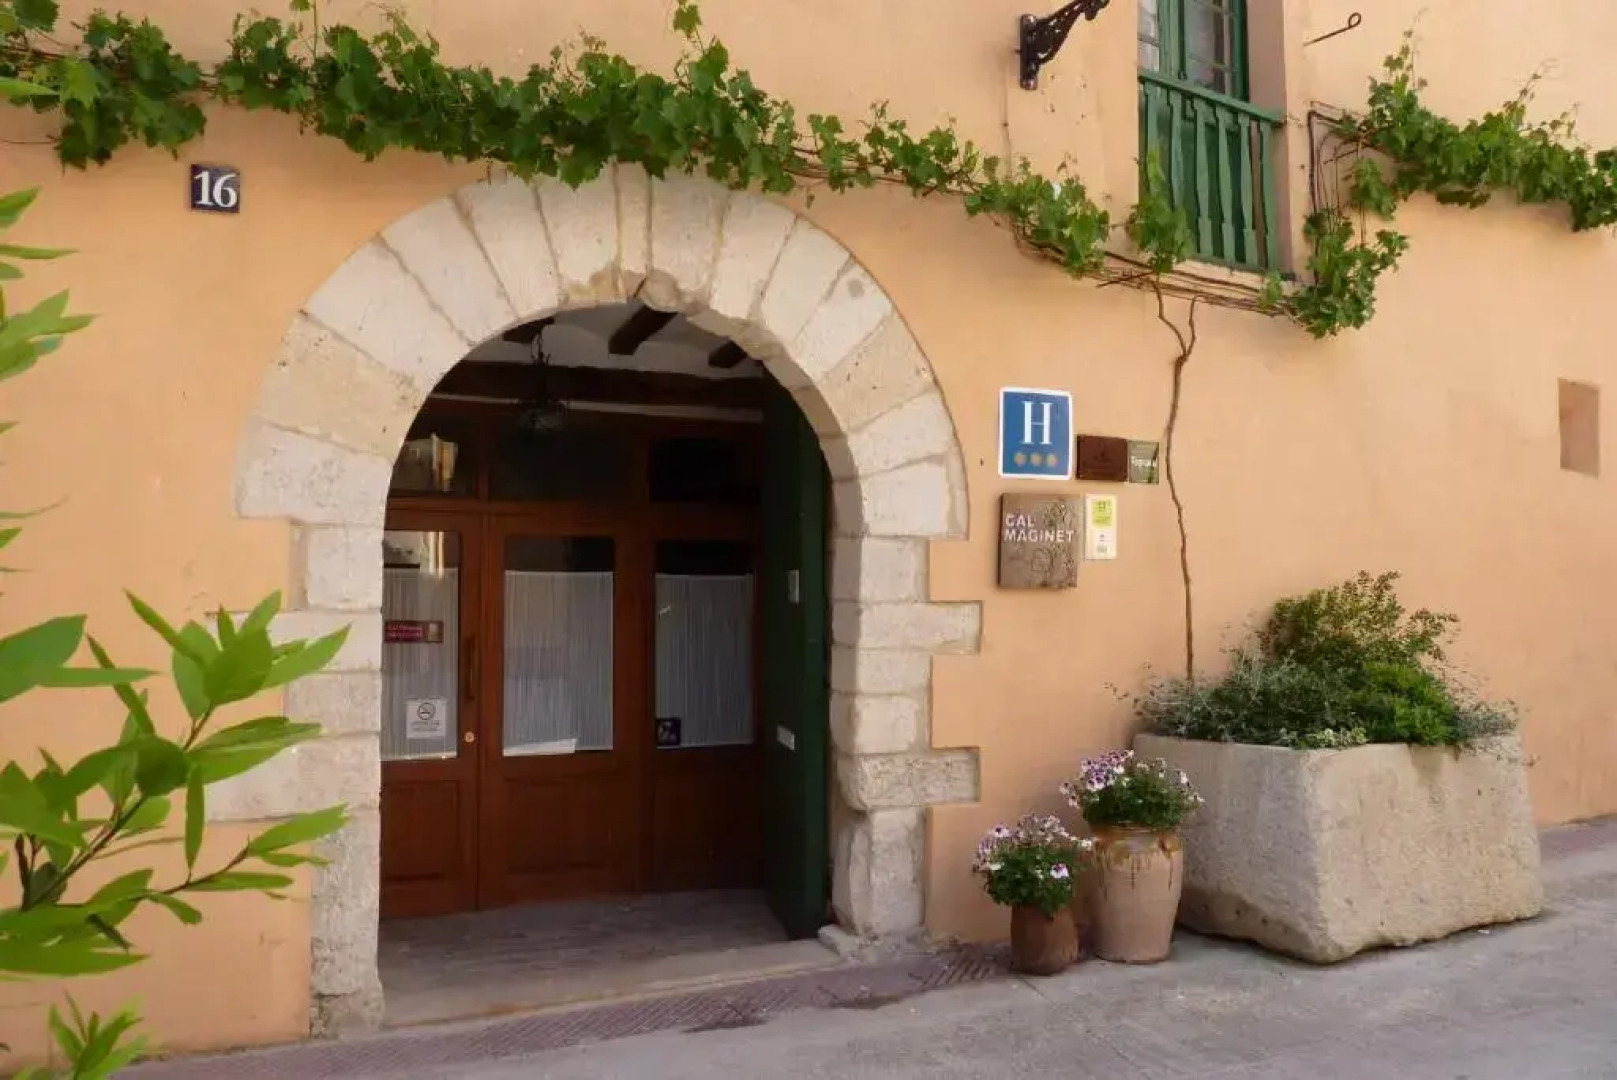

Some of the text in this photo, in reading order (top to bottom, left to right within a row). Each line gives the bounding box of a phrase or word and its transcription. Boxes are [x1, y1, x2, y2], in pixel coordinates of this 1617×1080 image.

[194, 171, 238, 208] 16
[1020, 400, 1054, 445] H
[1005, 513, 1035, 528] CAL
[1004, 529, 1074, 543] MAGINET
